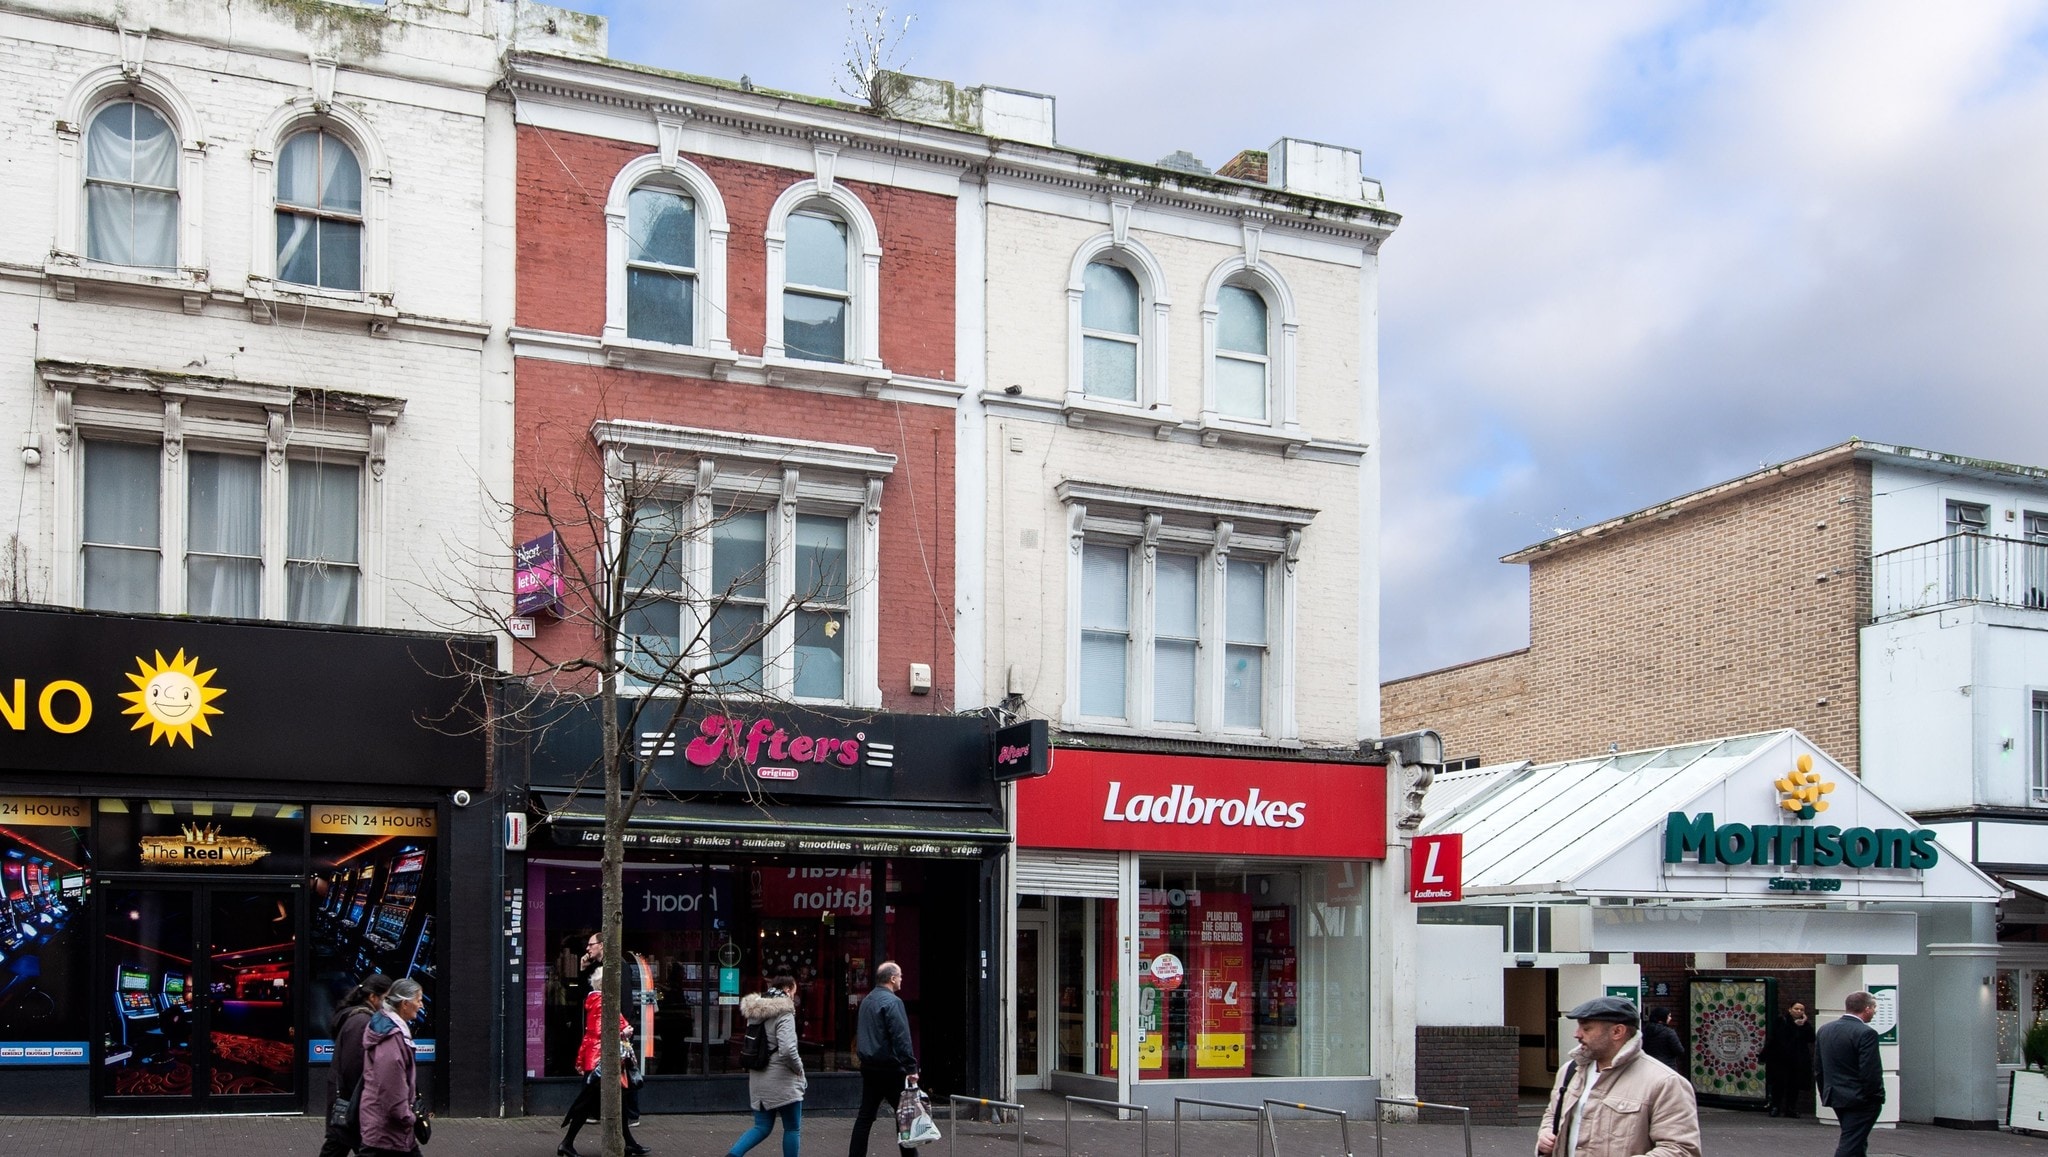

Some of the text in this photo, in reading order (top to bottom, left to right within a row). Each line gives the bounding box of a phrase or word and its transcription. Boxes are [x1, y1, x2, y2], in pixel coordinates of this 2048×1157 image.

[518, 572, 540, 589] let by
[685, 714, 860, 766] Afters
[761, 768, 796, 780] original
[2, 803, 80, 817] 24 HOURS
[1103, 781, 1307, 829] Ladbrokes
[320, 813, 432, 828] OPEN 24 HOURS
[582, 830, 982, 856] ice cam cakes shakes sundaes smoothies waffles coffee crêpes
[1665, 811, 1939, 870] Morrisons
[149, 844, 178, 859] The
[183, 846, 224, 860] Reel
[1422, 841, 1444, 884] L
[1768, 877, 1842, 892] Since 1899
[1414, 889, 1452, 898] Ladbrokes
[1206, 911, 1223, 922] PLUG
[1223, 911, 1238, 922] INTO
[1202, 921, 1243, 932] THE GRID FOR
[1201, 931, 1212, 942] BIG
[1213, 931, 1244, 942] REWARDS
